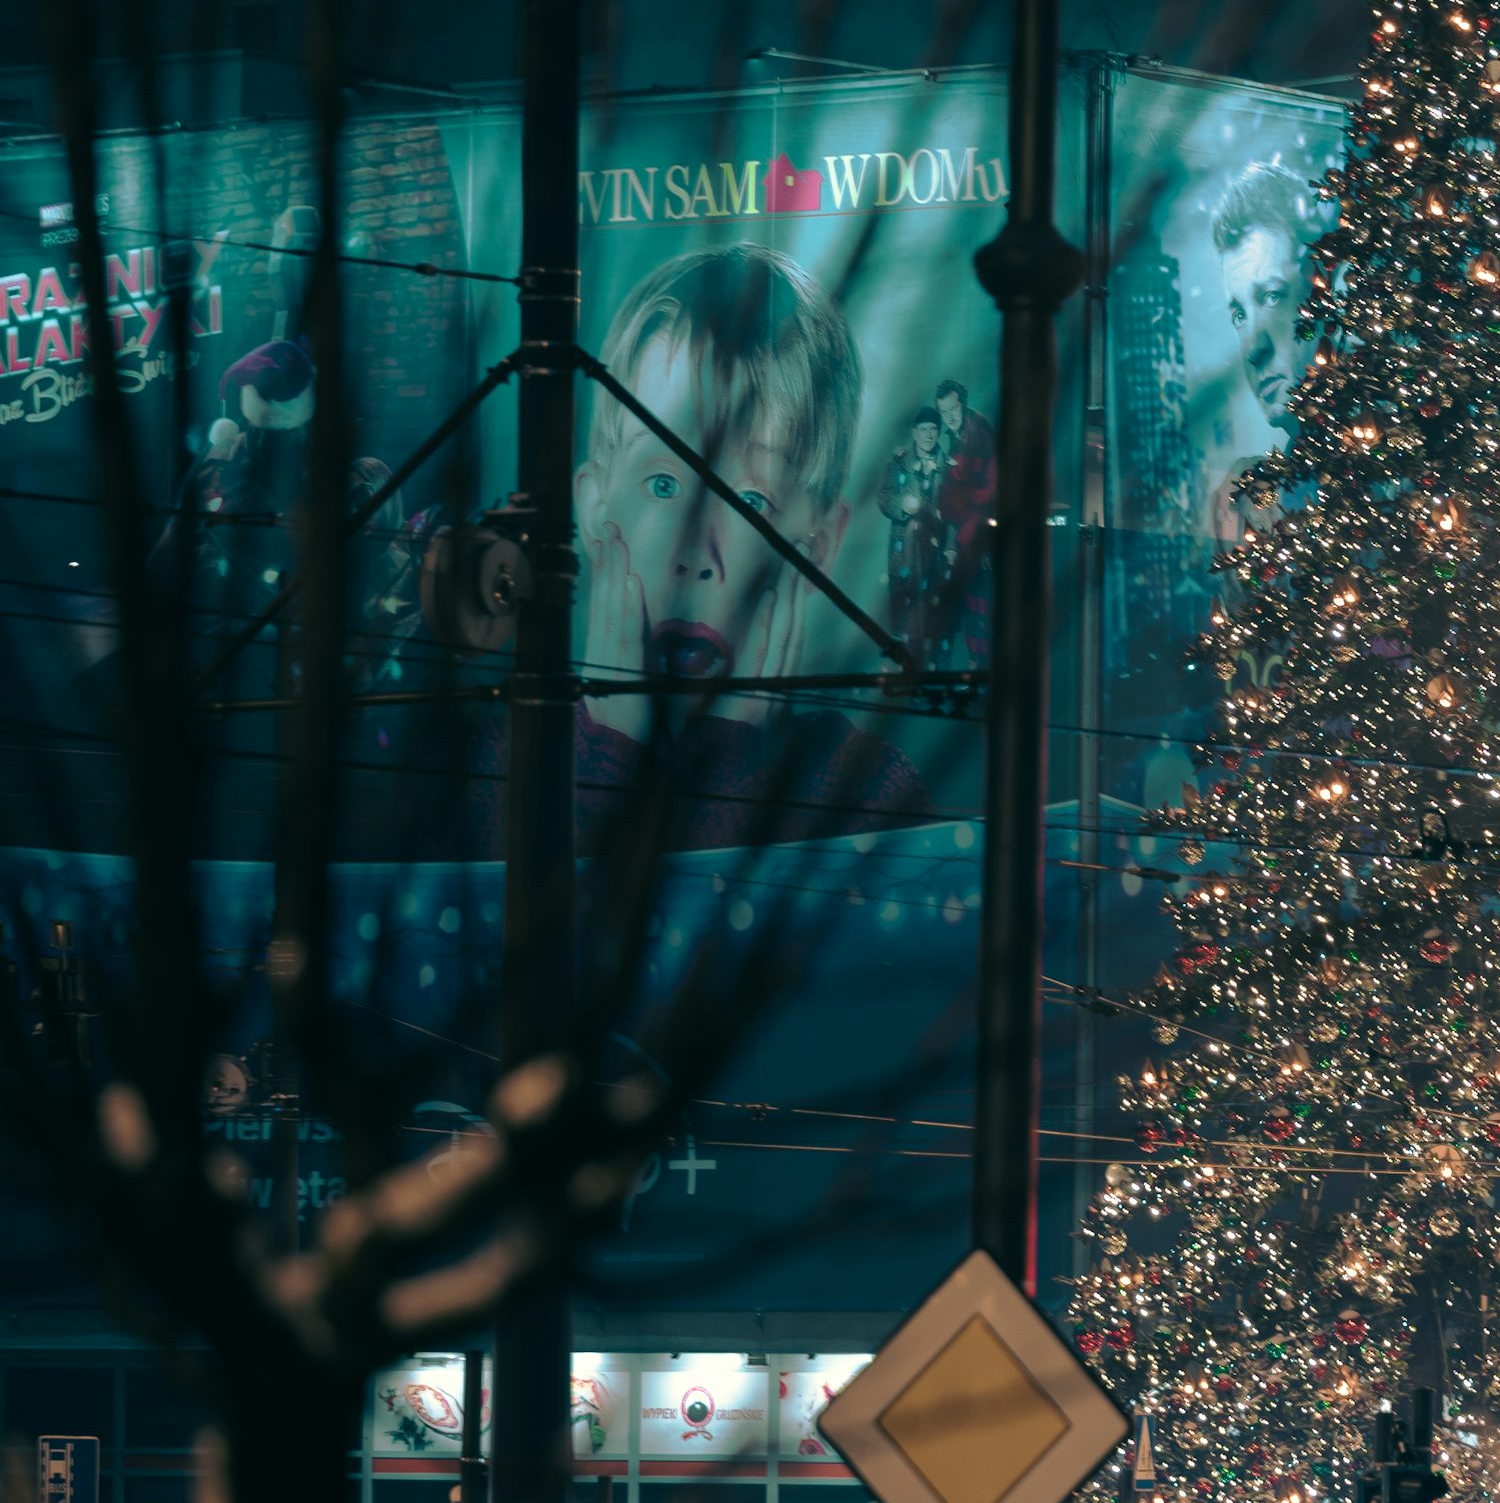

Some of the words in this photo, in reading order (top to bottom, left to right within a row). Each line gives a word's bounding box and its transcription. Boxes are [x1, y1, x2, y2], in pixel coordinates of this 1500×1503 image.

[579, 166, 658, 224] VIN
[664, 160, 761, 220] SAM
[824, 153, 872, 210] W
[0, 230, 231, 326] RANIY
[0, 285, 224, 377] LAKTYI
[642, 1407, 678, 1420] WYPIEKI
